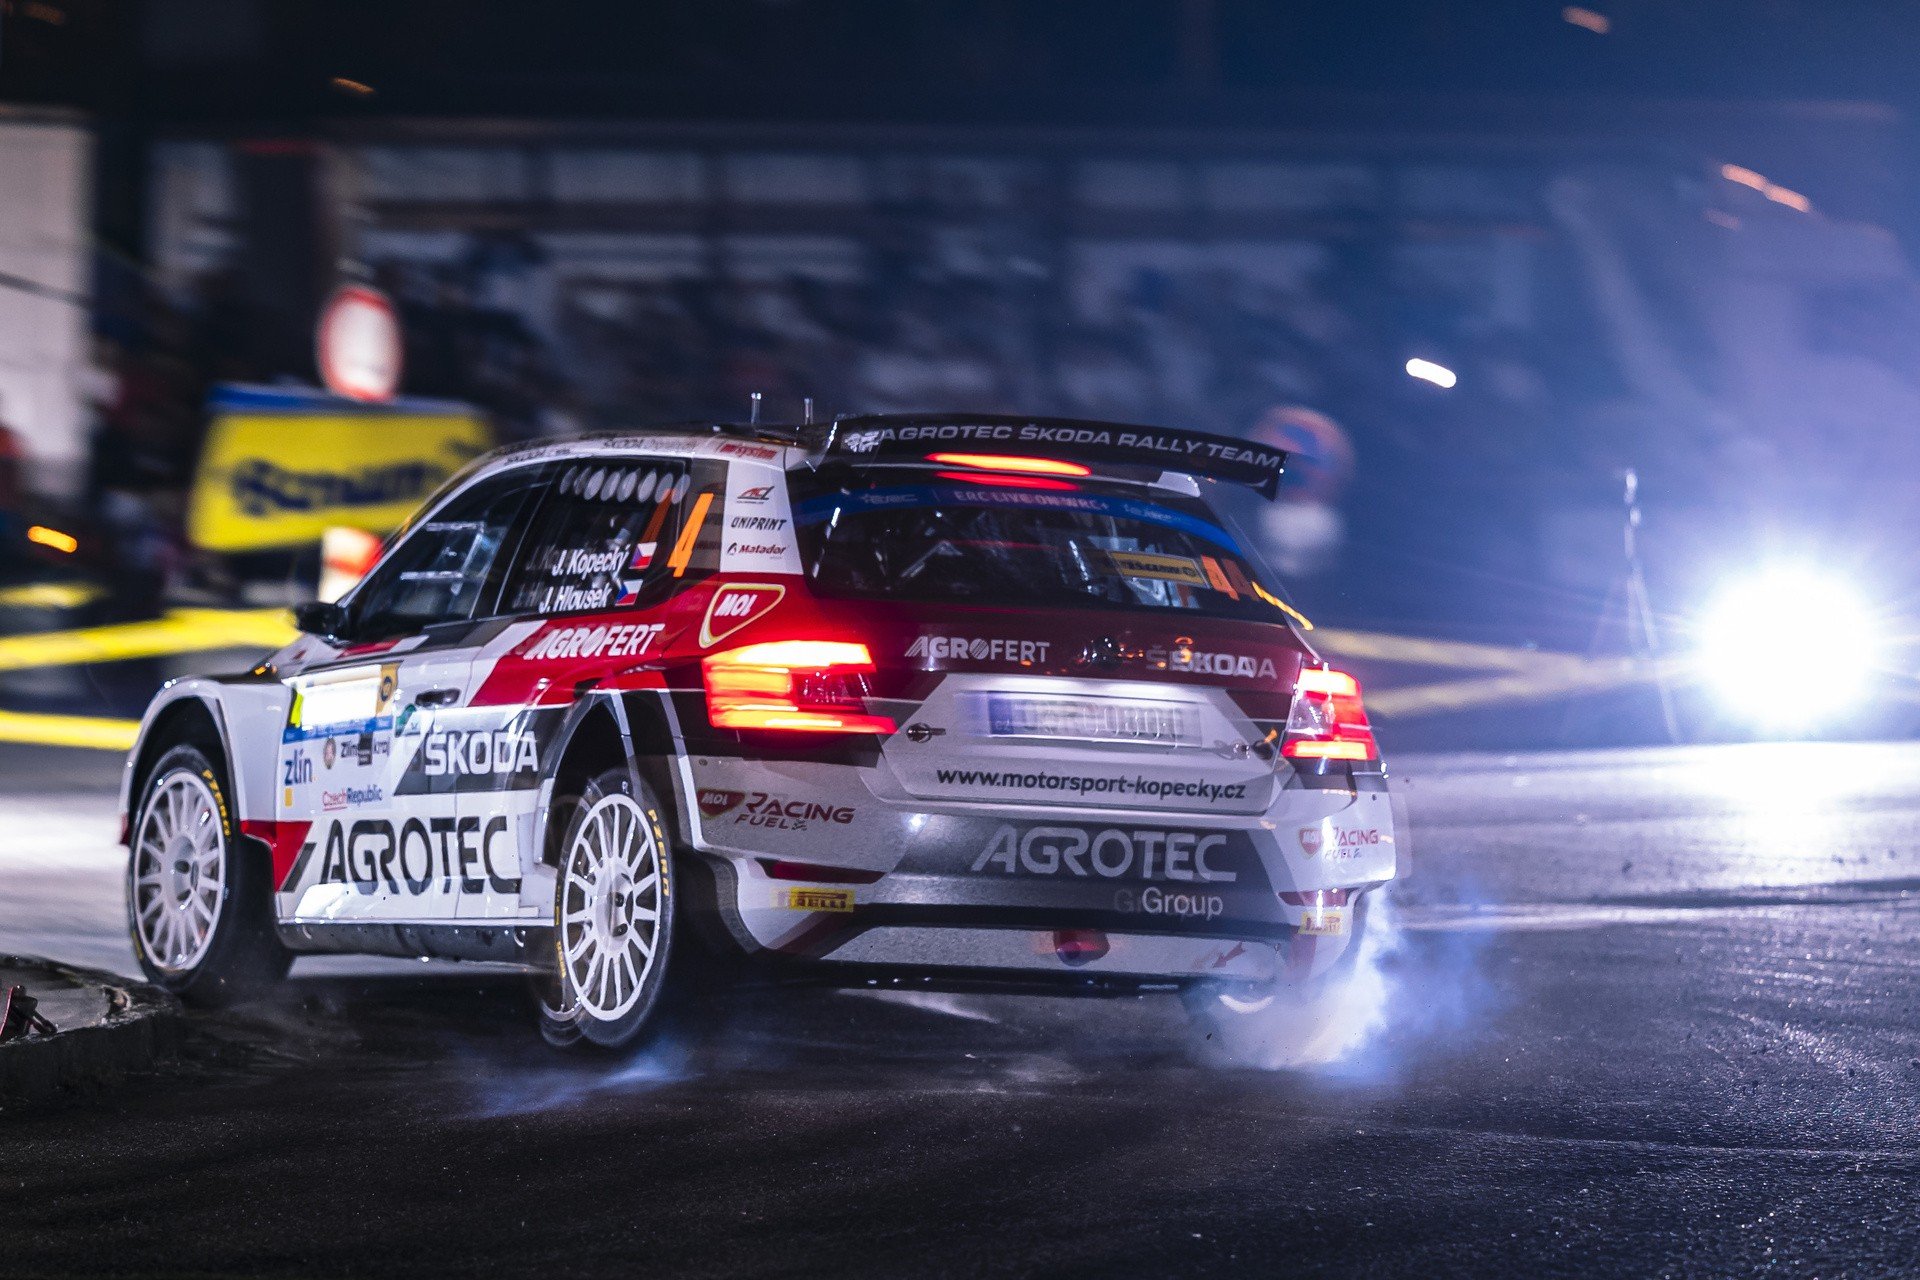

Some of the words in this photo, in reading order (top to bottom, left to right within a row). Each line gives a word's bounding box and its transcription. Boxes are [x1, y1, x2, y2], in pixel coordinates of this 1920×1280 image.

[882, 425, 1013, 441] AGROTEC
[1018, 423, 1111, 444] ŠKODA
[1117, 432, 1202, 454] RALLY
[1206, 442, 1281, 468] TEAM
[738, 544, 787, 555] Matador
[522, 622, 666, 661] AGROFERT
[904, 635, 1051, 664] AGROFERT
[424, 725, 540, 776] ŠKODA
[936, 769, 1246, 803] www.motorsport-kopecky.cz
[734, 813, 789, 830] FUEL
[745, 791, 857, 825] RACING
[319, 815, 523, 896] AGROTEC
[970, 825, 1237, 883] AGROTEC
[1142, 886, 1223, 919] Group
